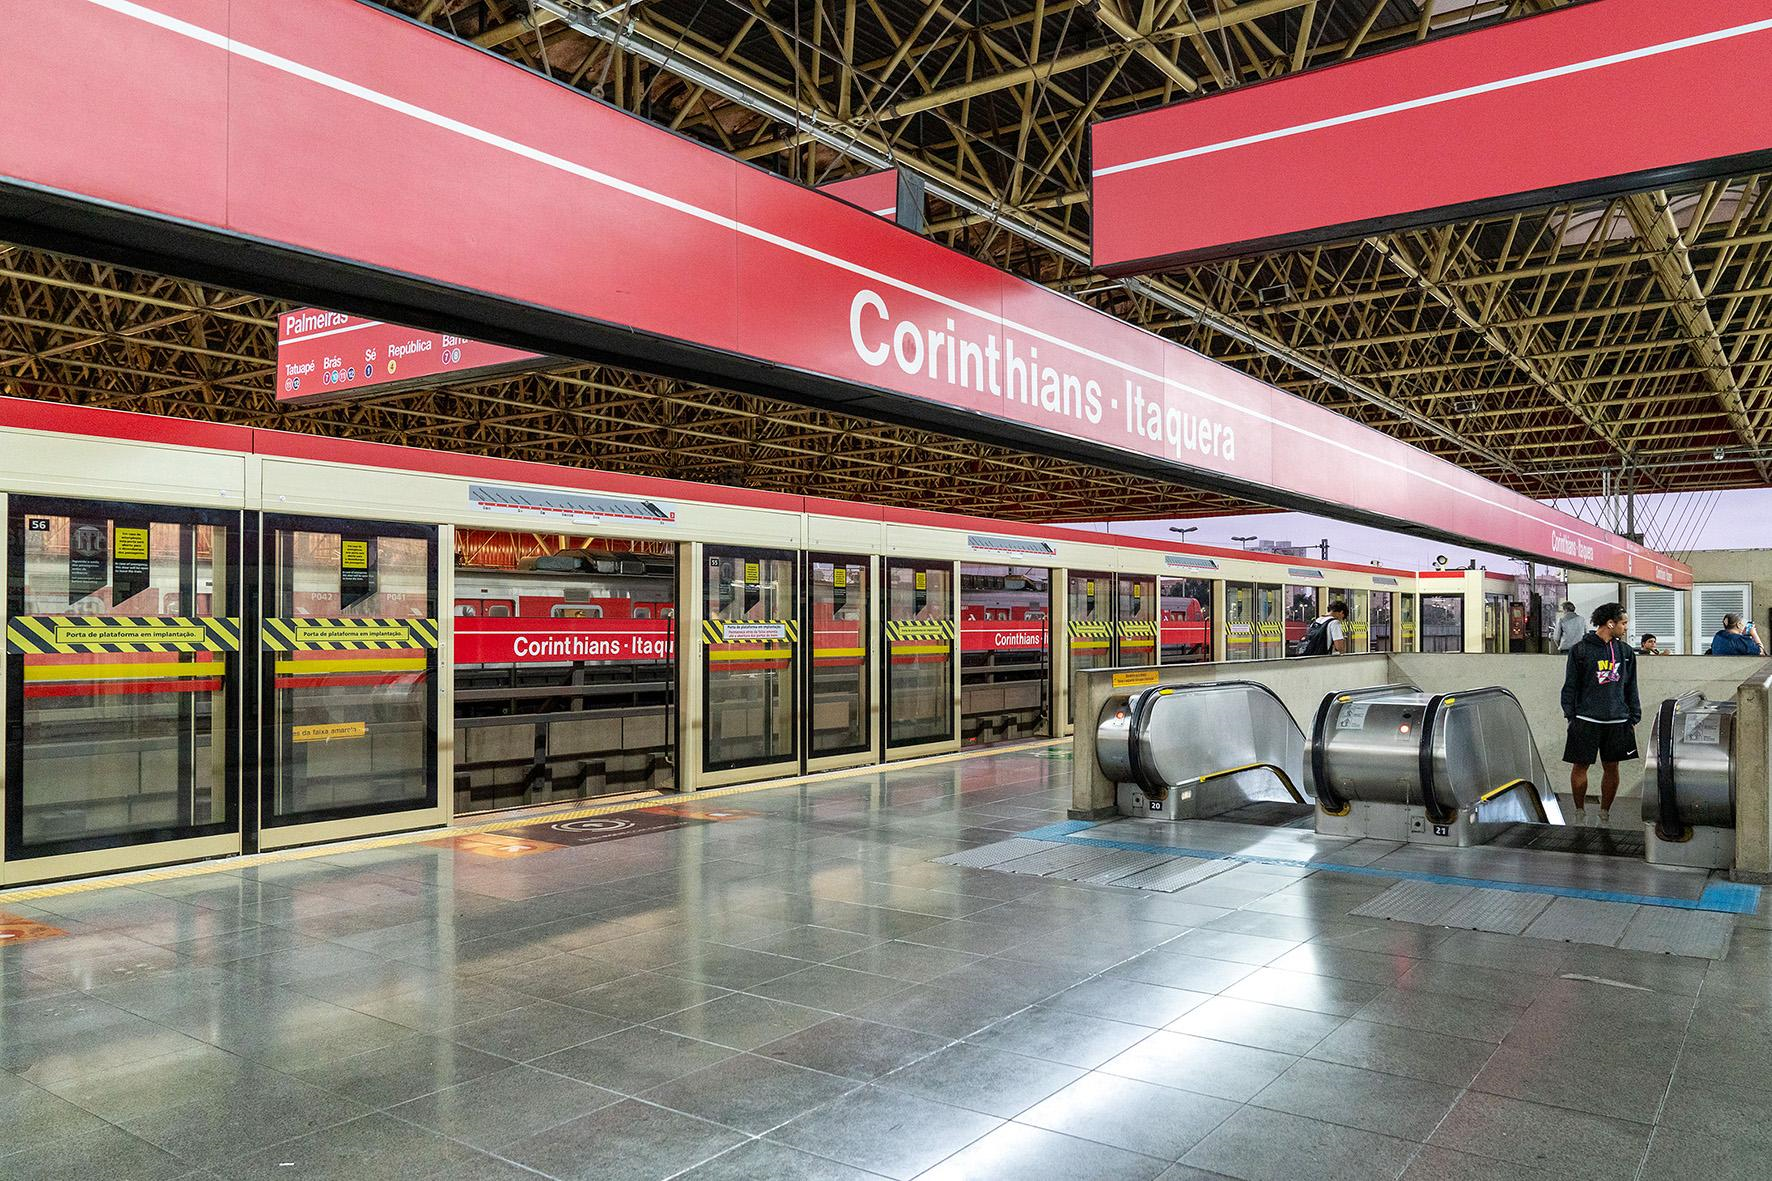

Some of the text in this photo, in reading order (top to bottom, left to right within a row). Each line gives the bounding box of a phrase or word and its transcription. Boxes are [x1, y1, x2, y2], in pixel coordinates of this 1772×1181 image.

[364, 347, 377, 362] Sé
[388, 339, 433, 359] República
[285, 360, 315, 376] Tatuapé
[323, 355, 342, 370] Brás
[849, 288, 1236, 461] Corinthians Itaquera
[32, 520, 46, 529] 56
[1552, 529, 1576, 557] Corinthians
[311, 592, 333, 601] P042
[386, 593, 406, 601] P041
[99, 631, 139, 639] plataforma
[153, 631, 197, 639] implantação.
[995, 632, 1040, 647] Corinthians
[513, 636, 621, 657] Corinthians
[1435, 826, 1446, 835] 21
